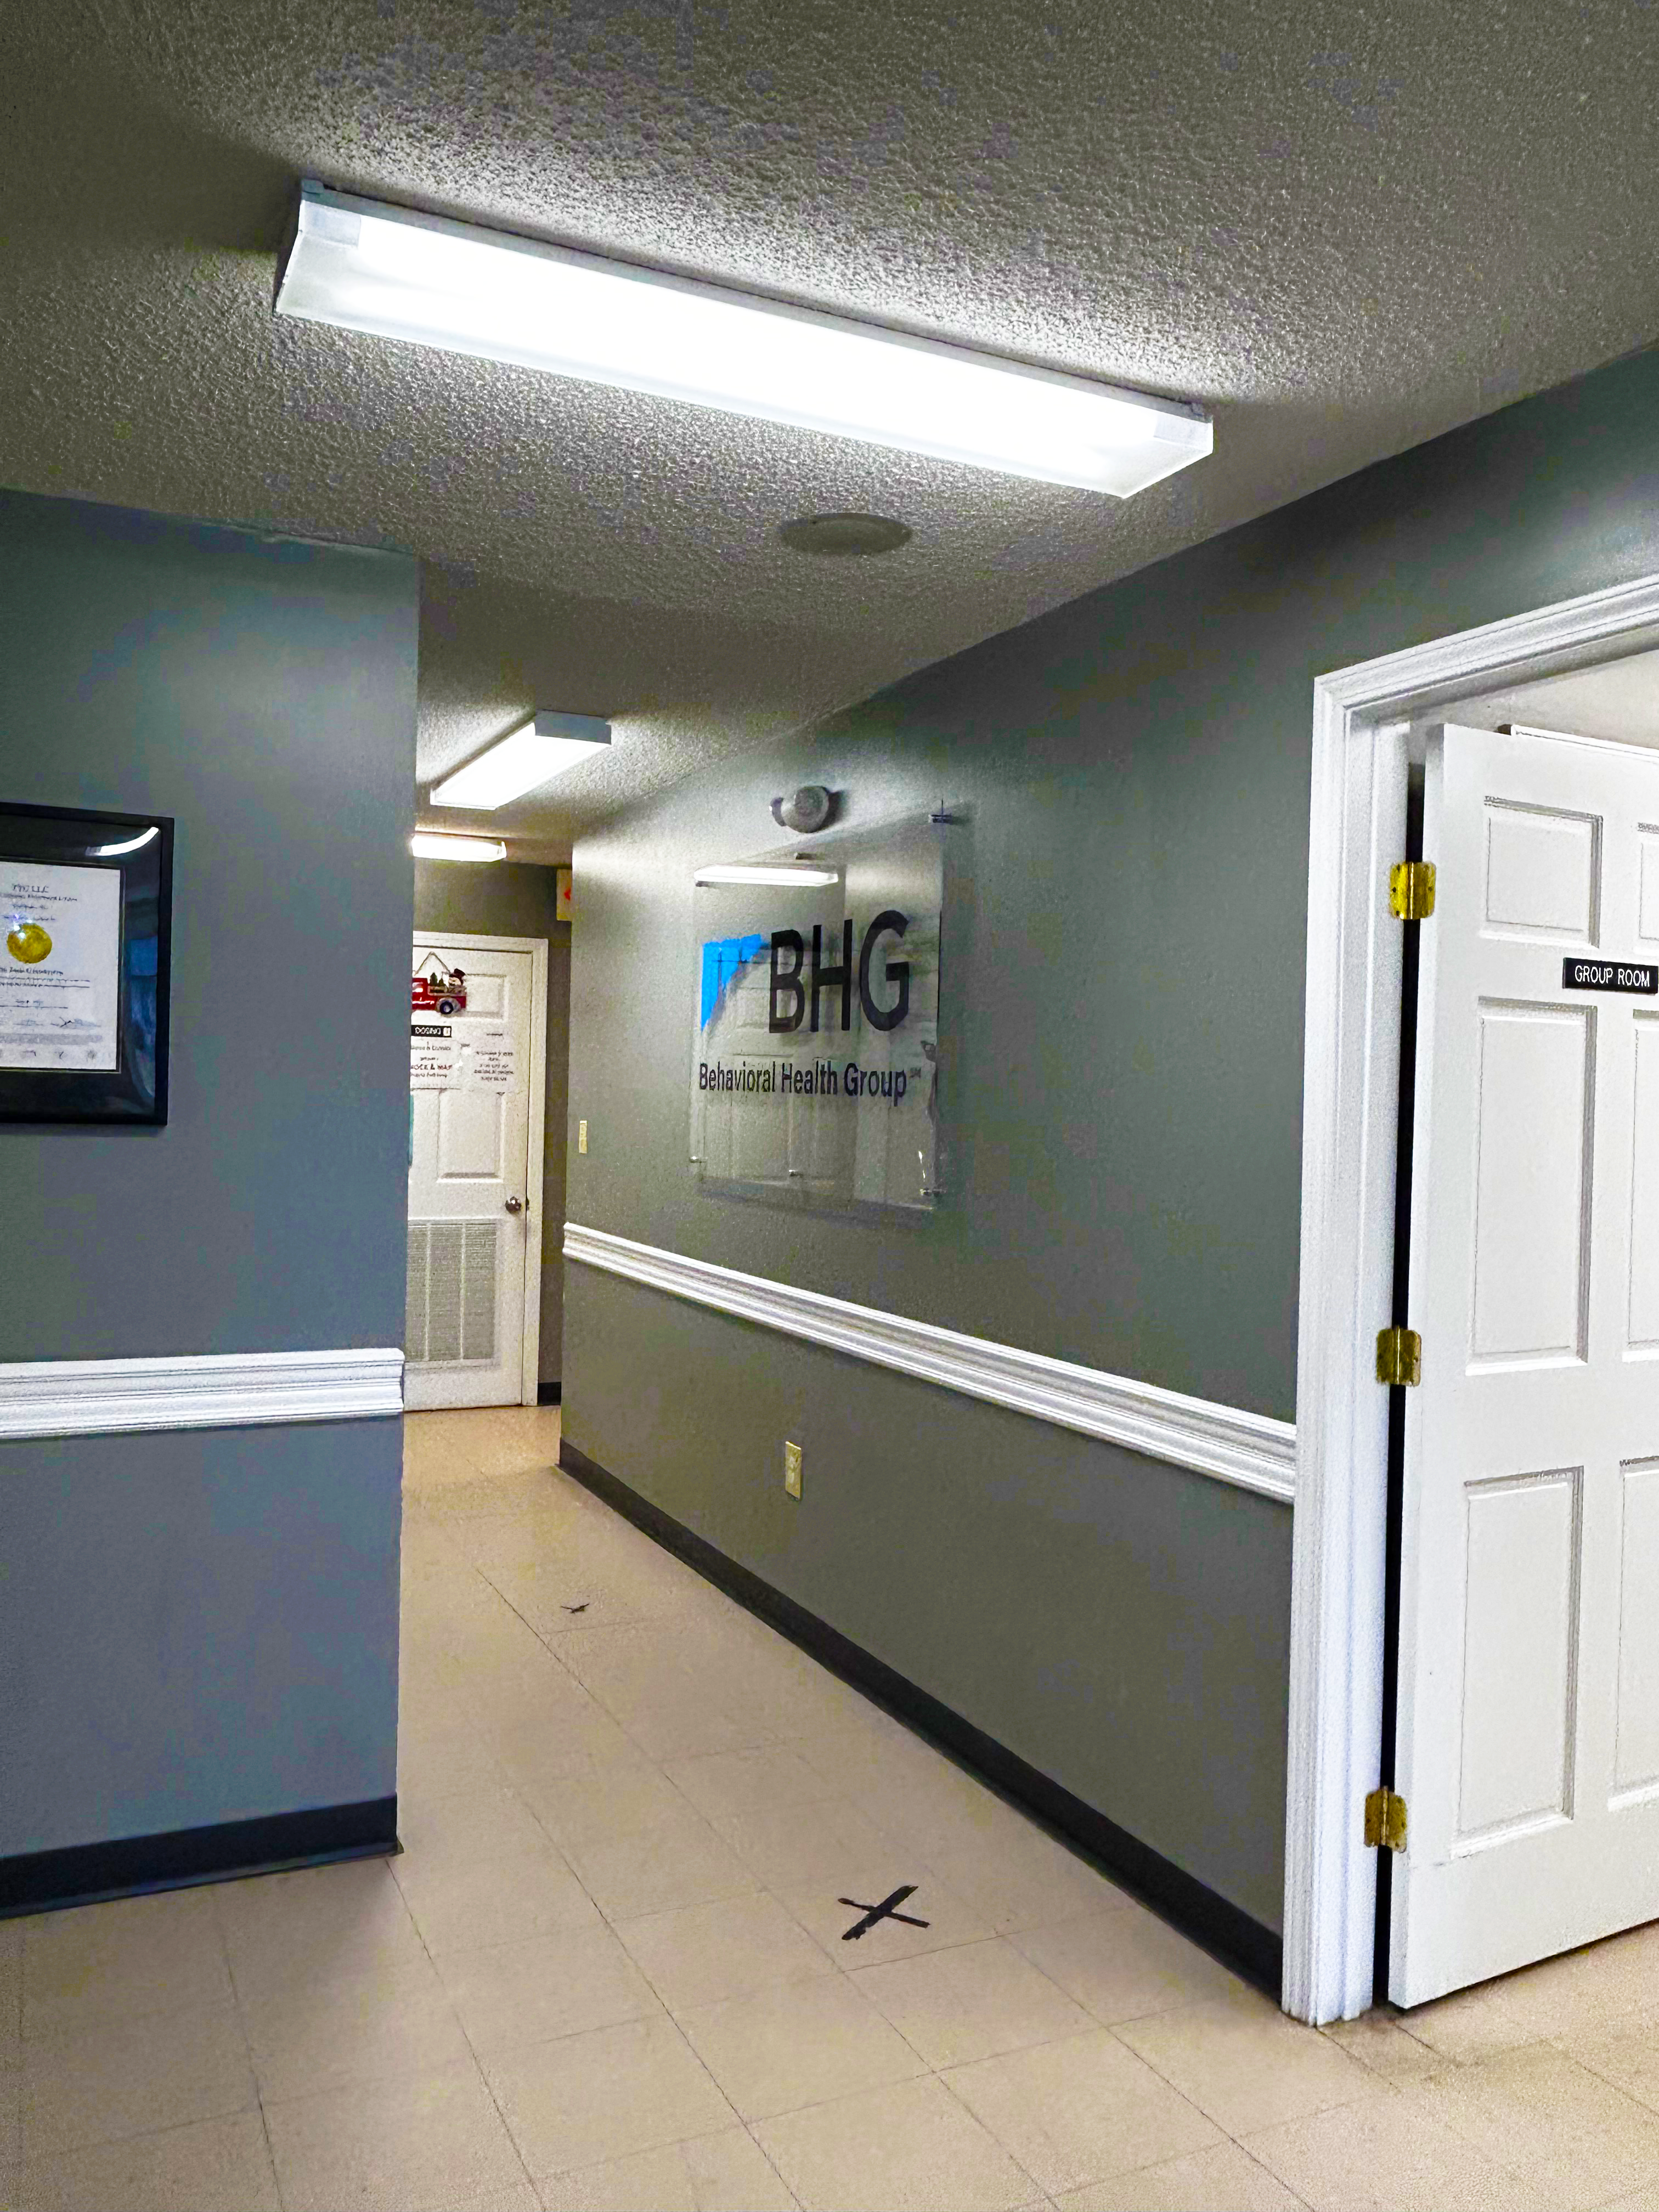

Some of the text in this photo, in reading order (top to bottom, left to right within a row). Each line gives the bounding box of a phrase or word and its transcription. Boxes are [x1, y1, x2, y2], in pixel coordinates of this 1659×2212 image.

[770, 910, 910, 1033] BHG
[1575, 965, 1650, 987] GROUP ROOM
[699, 1062, 775, 1092] Behavioral
[781, 1061, 838, 1094] Health
[844, 1063, 907, 1107] Group
